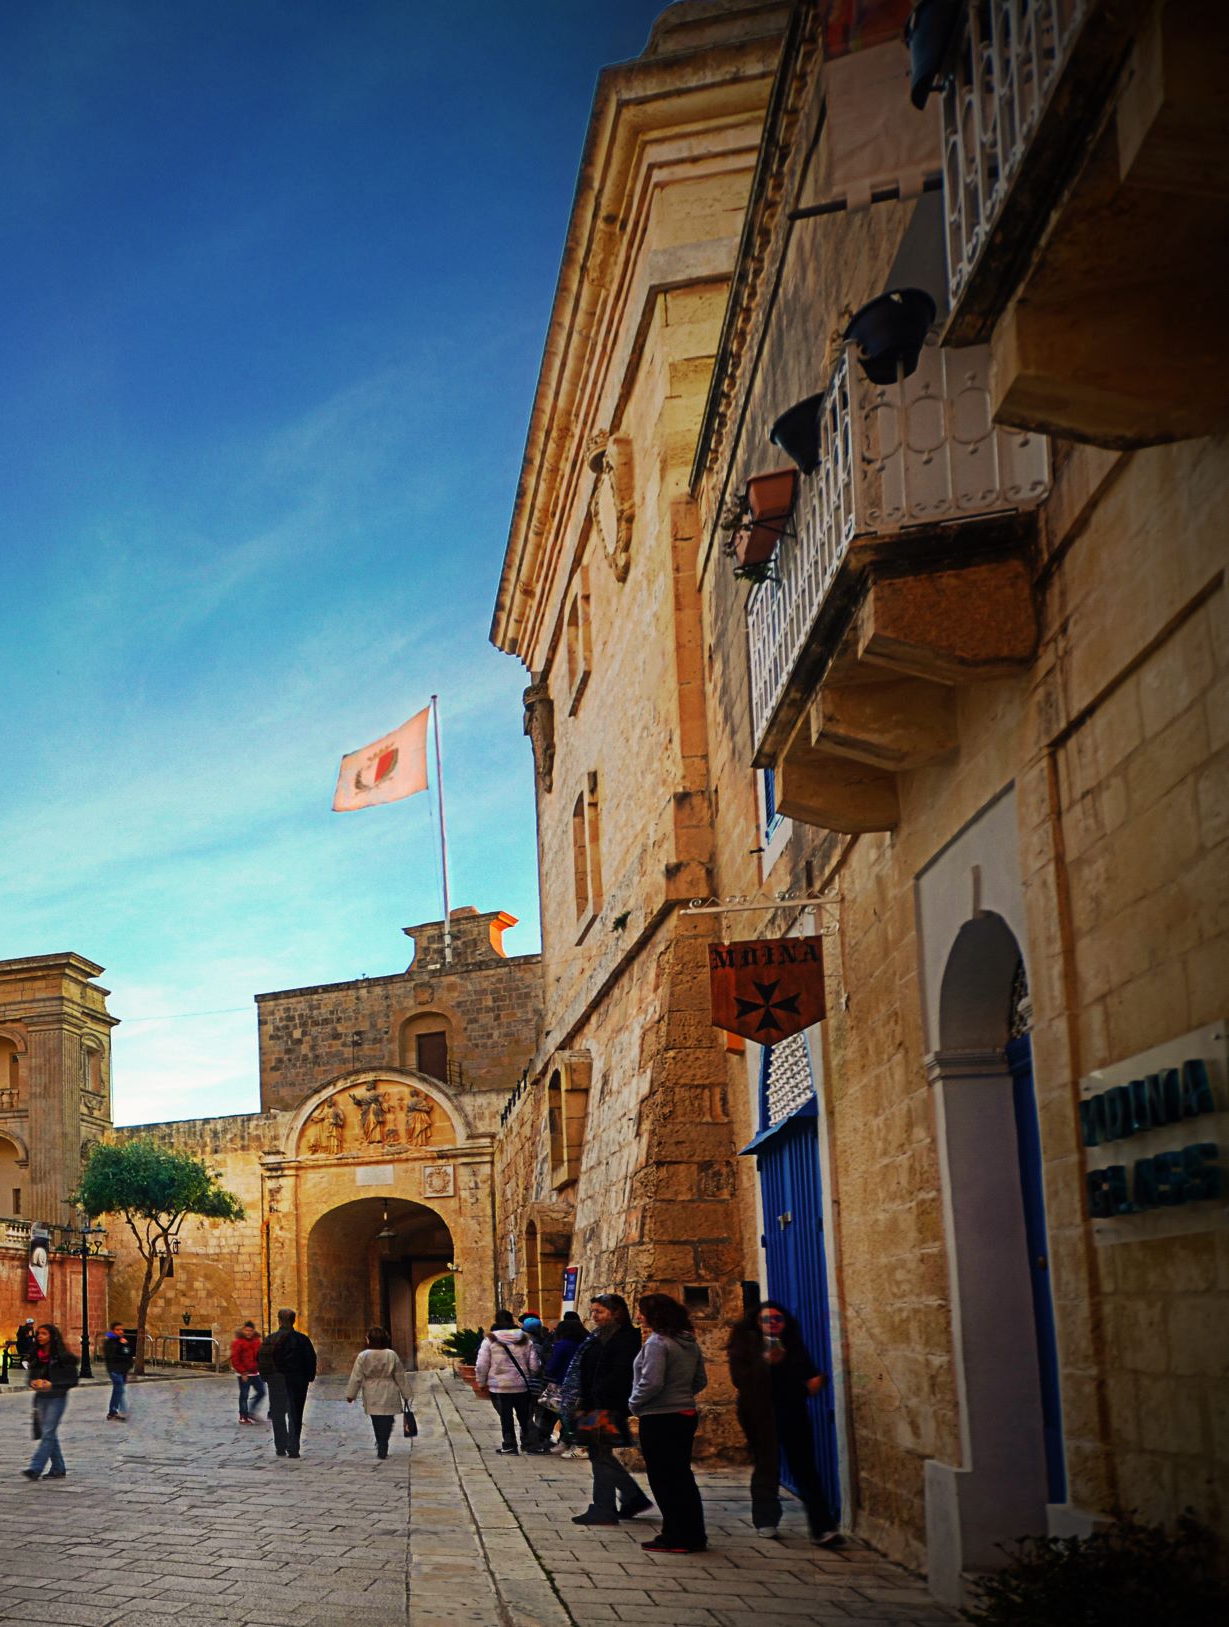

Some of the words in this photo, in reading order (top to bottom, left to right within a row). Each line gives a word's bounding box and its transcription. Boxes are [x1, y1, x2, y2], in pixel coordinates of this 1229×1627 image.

[711, 944, 820, 970] MDINA
[1078, 1059, 1215, 1147] MDINA
[1086, 1142, 1221, 1218] GLASS
